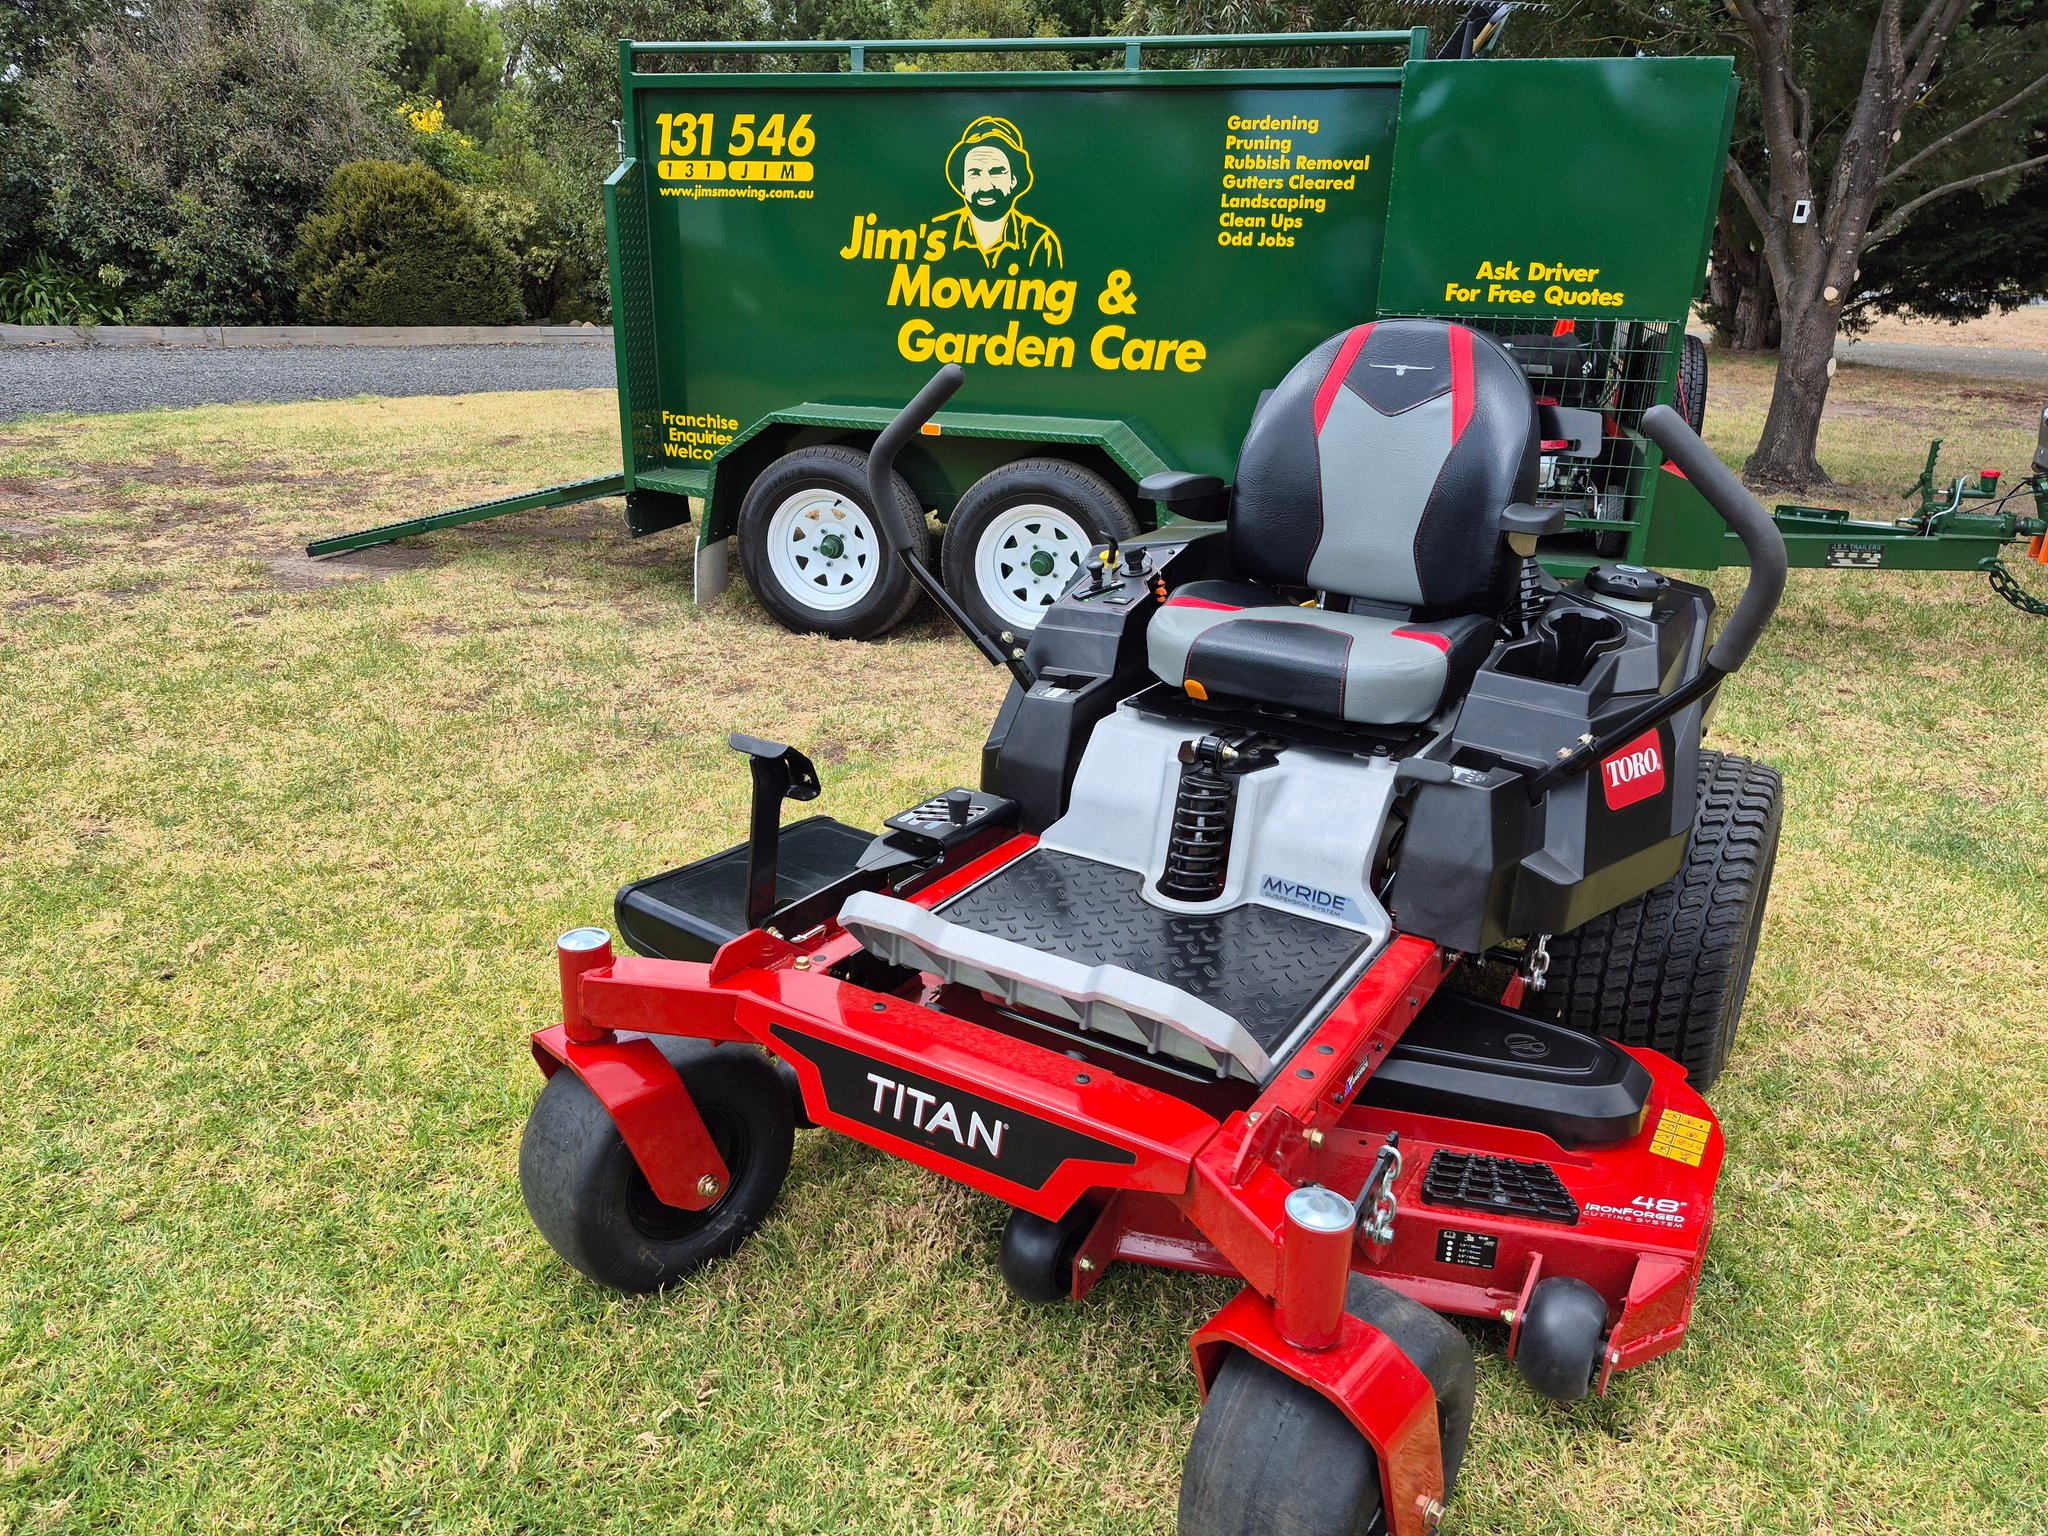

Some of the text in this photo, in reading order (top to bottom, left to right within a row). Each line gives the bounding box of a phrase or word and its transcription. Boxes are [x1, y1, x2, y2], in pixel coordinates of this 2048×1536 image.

[1227, 114, 1319, 134] Gardening
[656, 113, 816, 157] 131 546
[1225, 135, 1291, 153] Pruning
[1223, 154, 1370, 171] Rubbish Removal
[1222, 174, 1356, 190] Gutters Cleared
[659, 185, 814, 201] www.jimsmowing.com.au
[1220, 193, 1326, 213] Landscaping
[1219, 212, 1303, 231] Clean Ups
[840, 212, 947, 261] Jim's
[1217, 231, 1295, 247] Odd Jobs
[1475, 261, 1600, 282] Ask Driver
[886, 263, 1138, 325] Mowing &
[1445, 283, 1624, 307] For Free Quotes
[897, 318, 1207, 372] Garden Care
[662, 410, 739, 430] Franchise
[668, 427, 733, 446] Enquiries
[664, 443, 717, 461] Welco
[1605, 747, 1658, 787] TORO
[867, 1072, 1004, 1158] TITAN
[1582, 1210, 1683, 1228] CUTTING SYSTEM
